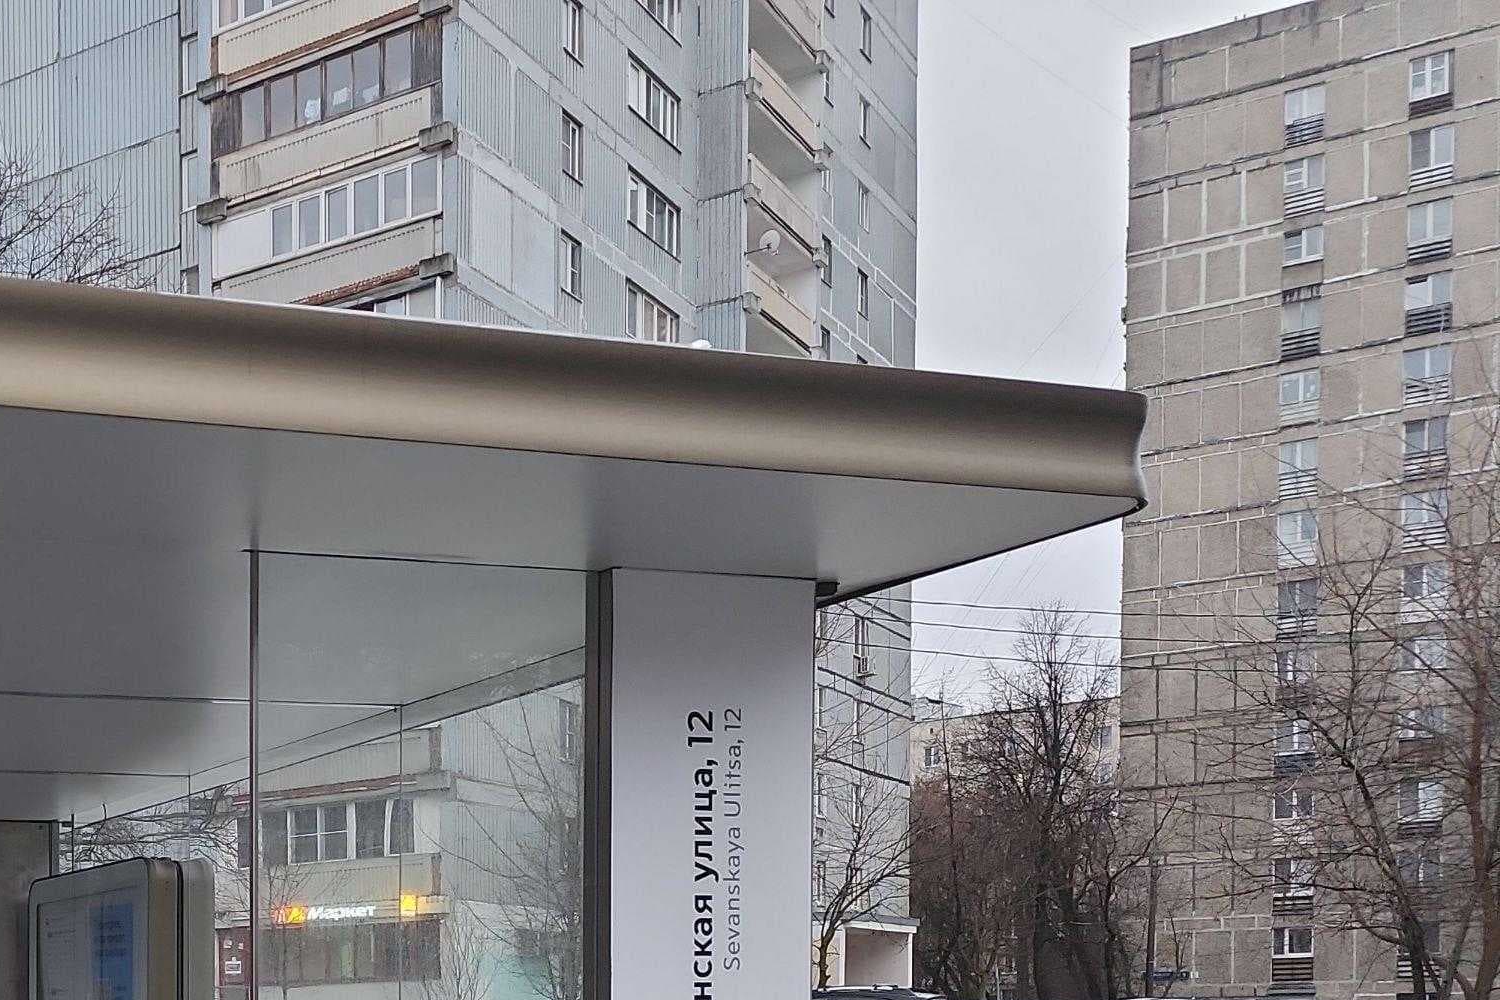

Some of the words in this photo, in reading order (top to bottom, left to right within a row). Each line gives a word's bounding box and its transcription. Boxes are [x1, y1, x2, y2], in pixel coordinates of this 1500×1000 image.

[687, 710, 714, 748] 12
[723, 708, 743, 731] 12
[723, 739, 745, 818] Ulitsa,
[693, 759, 719, 882] улица,
[306, 905, 376, 921] Маркет
[723, 826, 745, 971] Sevanskaya
